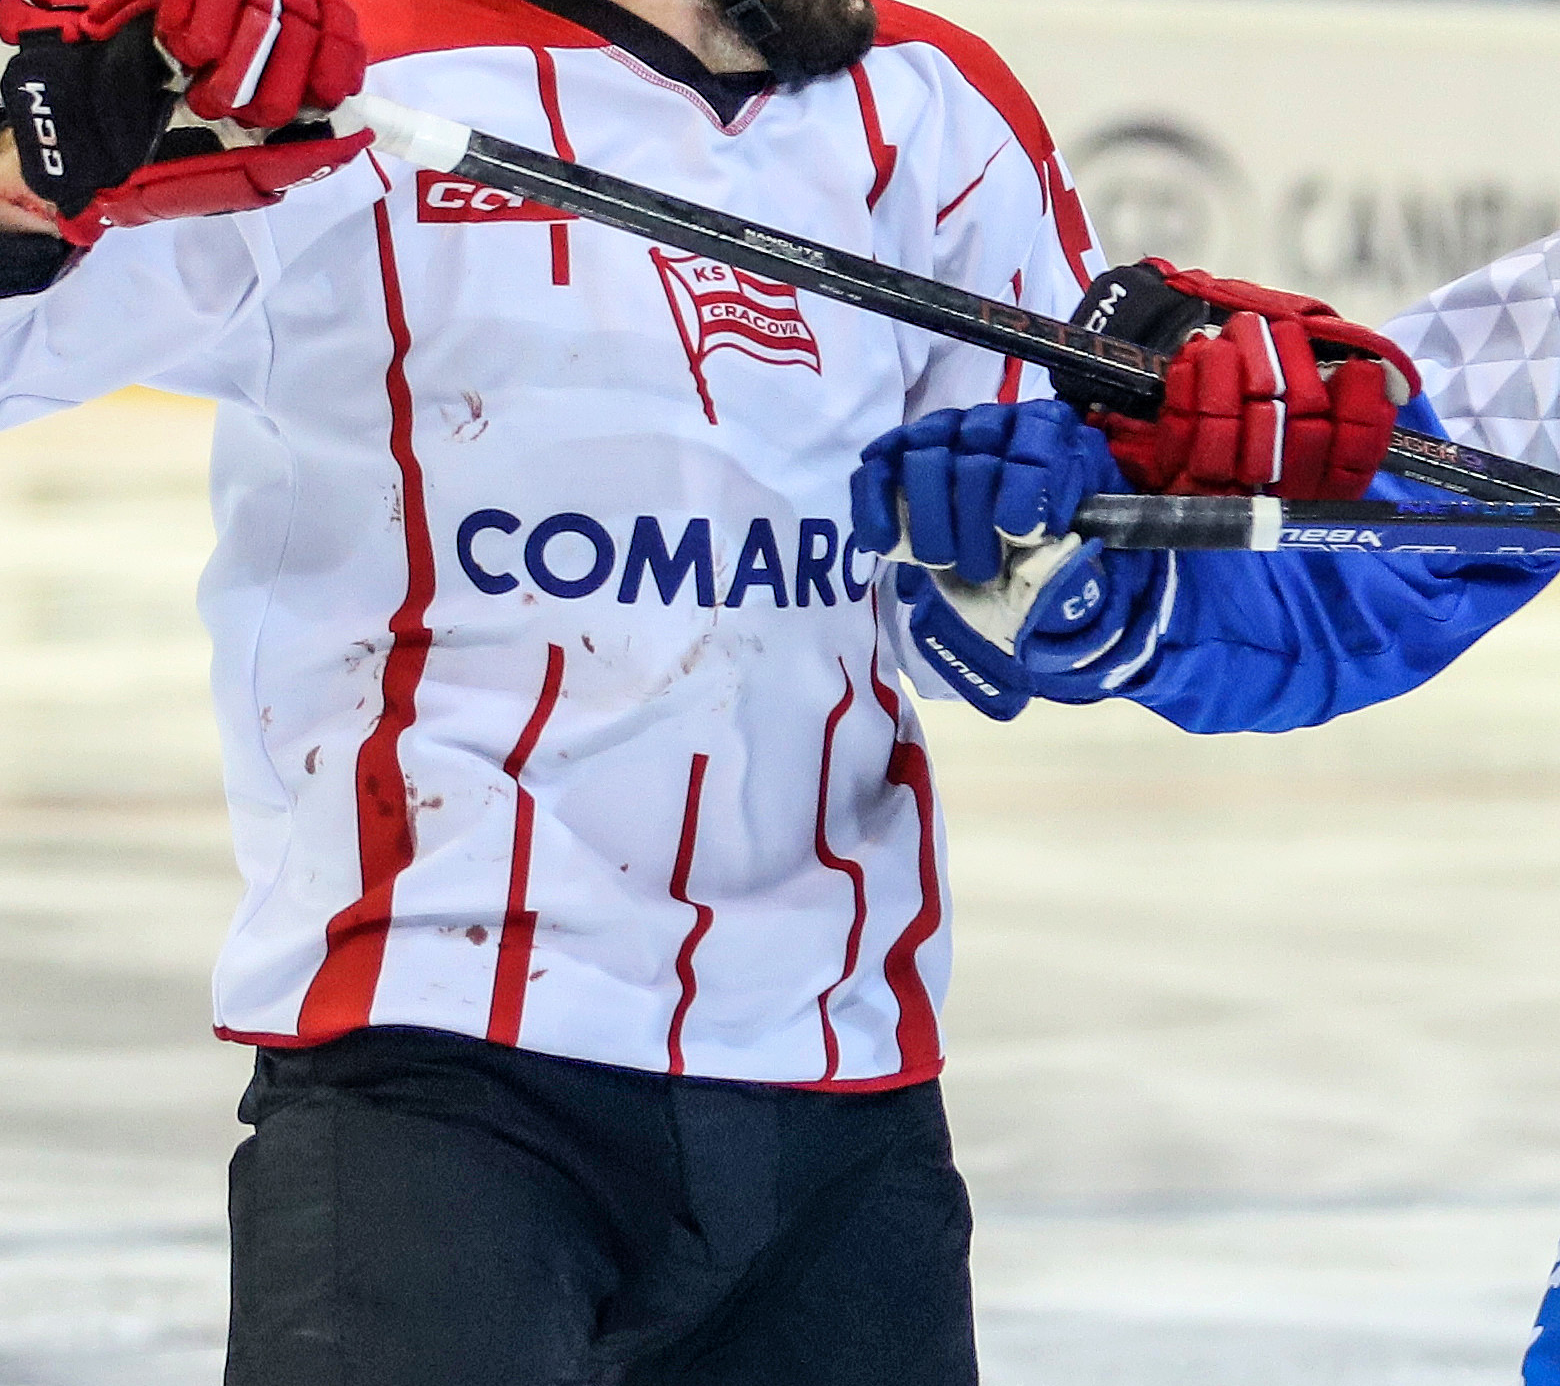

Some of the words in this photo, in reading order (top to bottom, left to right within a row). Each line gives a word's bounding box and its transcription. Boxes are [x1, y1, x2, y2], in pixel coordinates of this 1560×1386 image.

[18, 80, 65, 177] CCM
[693, 264, 726, 283] KS
[709, 304, 802, 337] CRACOVIA
[1083, 282, 1128, 334] CM
[925, 636, 1001, 699] BAUER
